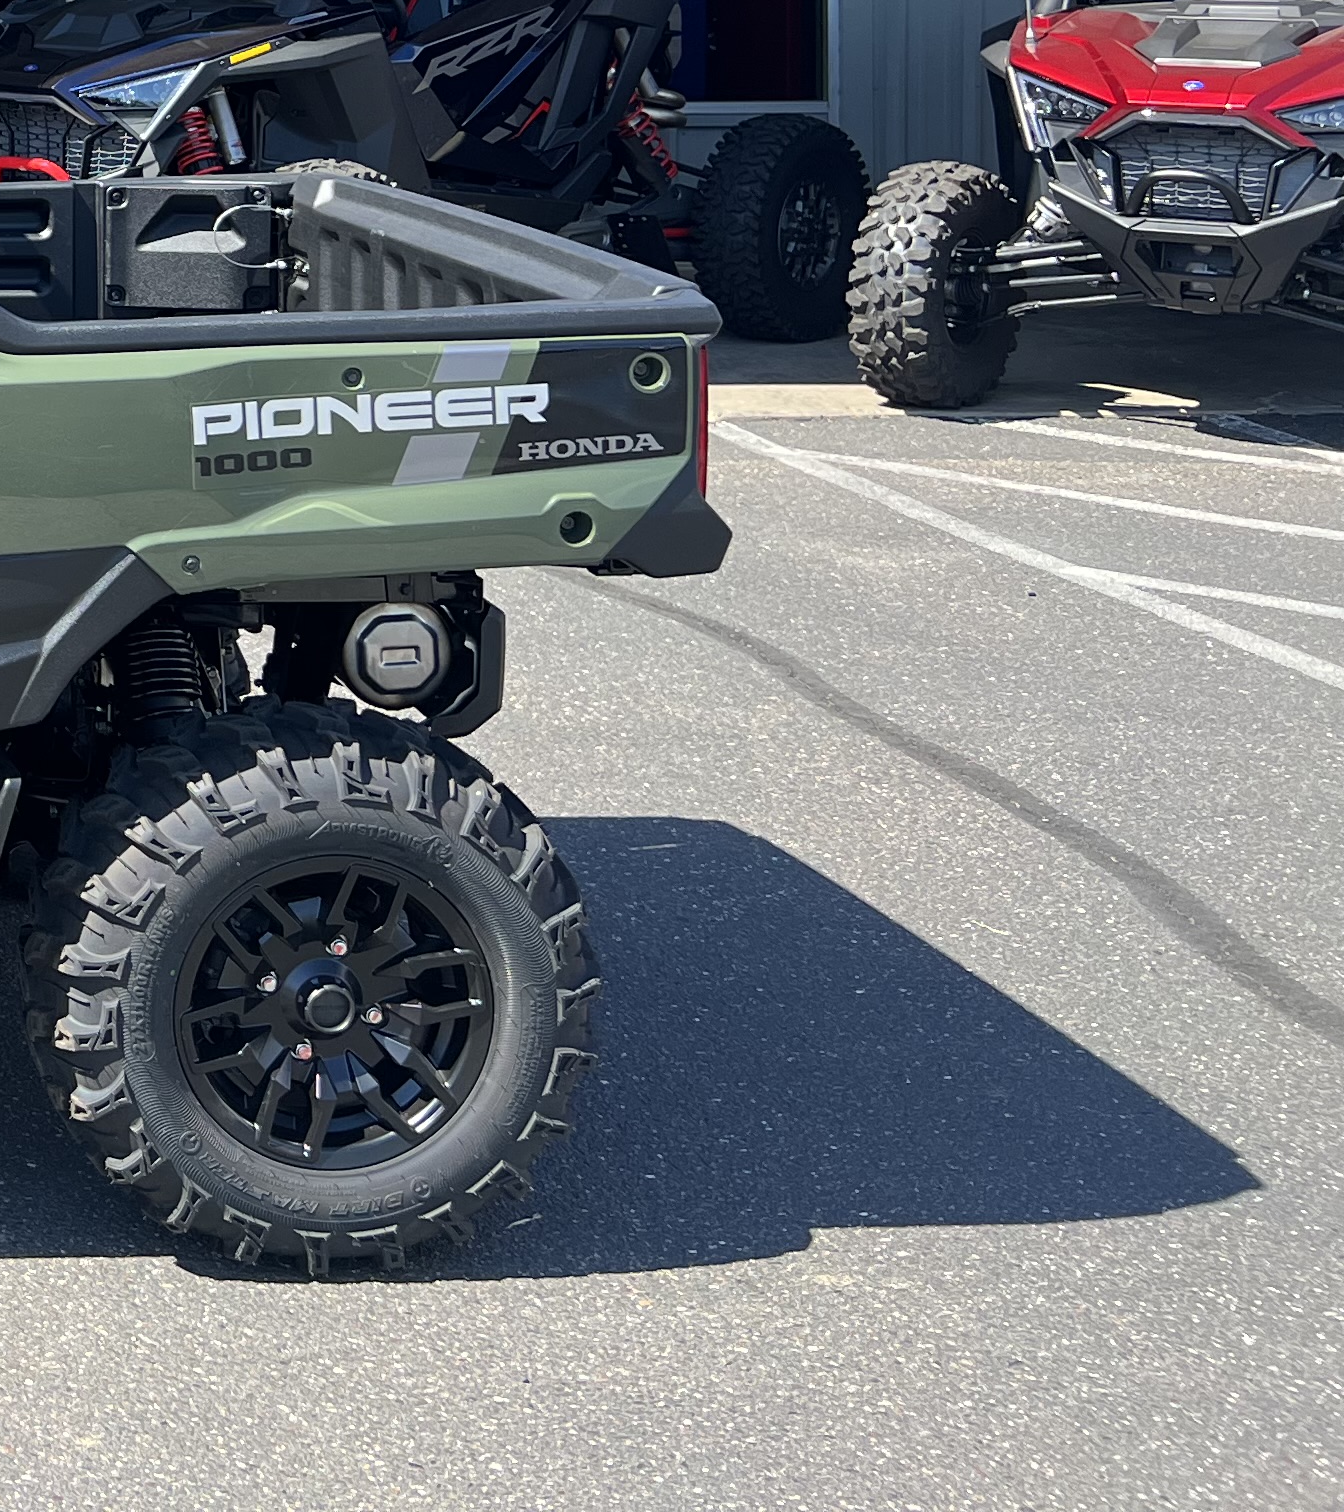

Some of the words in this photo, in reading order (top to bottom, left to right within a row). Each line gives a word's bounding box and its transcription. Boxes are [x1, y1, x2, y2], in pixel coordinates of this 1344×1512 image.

[412, 5, 555, 95] RZR
[192, 383, 550, 446] PIONEER
[194, 447, 313, 477] 1000
[518, 432, 665, 462] HONDA
